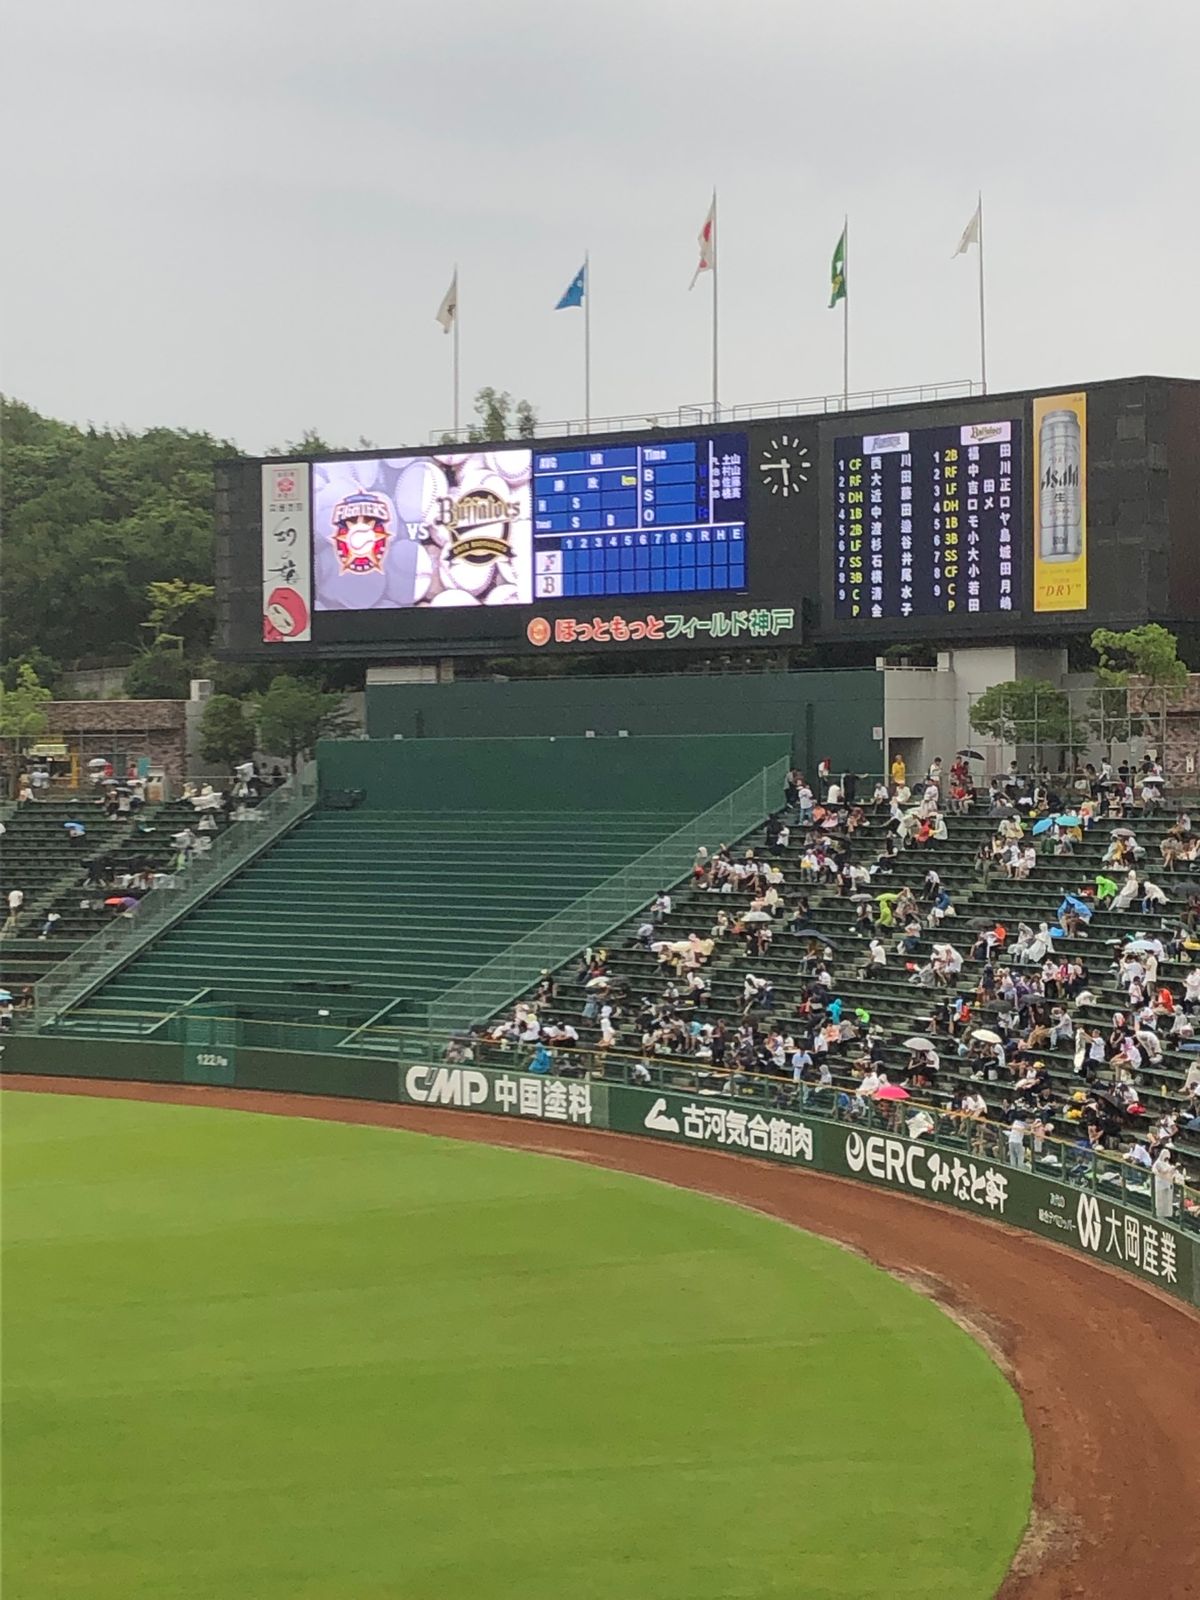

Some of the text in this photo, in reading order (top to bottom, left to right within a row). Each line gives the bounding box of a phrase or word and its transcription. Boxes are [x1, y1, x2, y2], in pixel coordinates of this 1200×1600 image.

[643, 449, 667, 461] Time
[933, 451, 940, 463] 1
[944, 448, 958, 461] 2B
[839, 460, 845, 471] 1
[849, 458, 862, 471] CF
[644, 469, 655, 482] B
[933, 468, 940, 480] 2
[944, 466, 957, 478] RF
[1041, 464, 1079, 490] Asahi
[838, 476, 845, 487] 2
[849, 475, 862, 487] RF
[644, 489, 655, 502] S
[933, 485, 940, 497] 3
[945, 483, 957, 496] LF
[572, 497, 581, 509] S
[839, 492, 845, 503] 3
[848, 491, 863, 503] DH
[435, 494, 520, 528] Buffaloes
[838, 508, 845, 520] 4
[849, 507, 862, 520] 1B
[933, 502, 940, 514] 4
[943, 500, 959, 512] DH
[644, 509, 655, 522] O
[572, 516, 581, 529] S
[933, 518, 940, 530] 5
[945, 516, 958, 529] 1B
[407, 523, 429, 540] VS
[839, 524, 845, 536] 5
[849, 523, 863, 536] 2B
[567, 529, 741, 549] 1 2 3 4 5 6 7 8 9 R H E
[838, 540, 845, 551] 6
[850, 539, 862, 551] LF
[933, 534, 940, 546] 6
[944, 532, 958, 545] 3B
[838, 556, 845, 568] 7
[849, 556, 862, 568] SS
[933, 551, 940, 563] 7
[944, 549, 958, 562] SS
[838, 572, 845, 583] 8
[849, 572, 863, 583] 3B
[933, 567, 940, 579] 8
[944, 566, 958, 578] CF
[839, 589, 845, 600] 9
[852, 588, 860, 600] C
[933, 584, 941, 596] 9
[948, 583, 956, 595] C
[852, 604, 860, 617] P
[948, 600, 956, 612] P
[555, 609, 794, 643] ほっともっとフィールド神戸
[405, 1065, 592, 1125] CMP 中国塗料
[682, 1103, 813, 1161] 古河気合筋肉
[866, 1136, 926, 1190] ERC
[1105, 1208, 1177, 1284] 大岡産業
